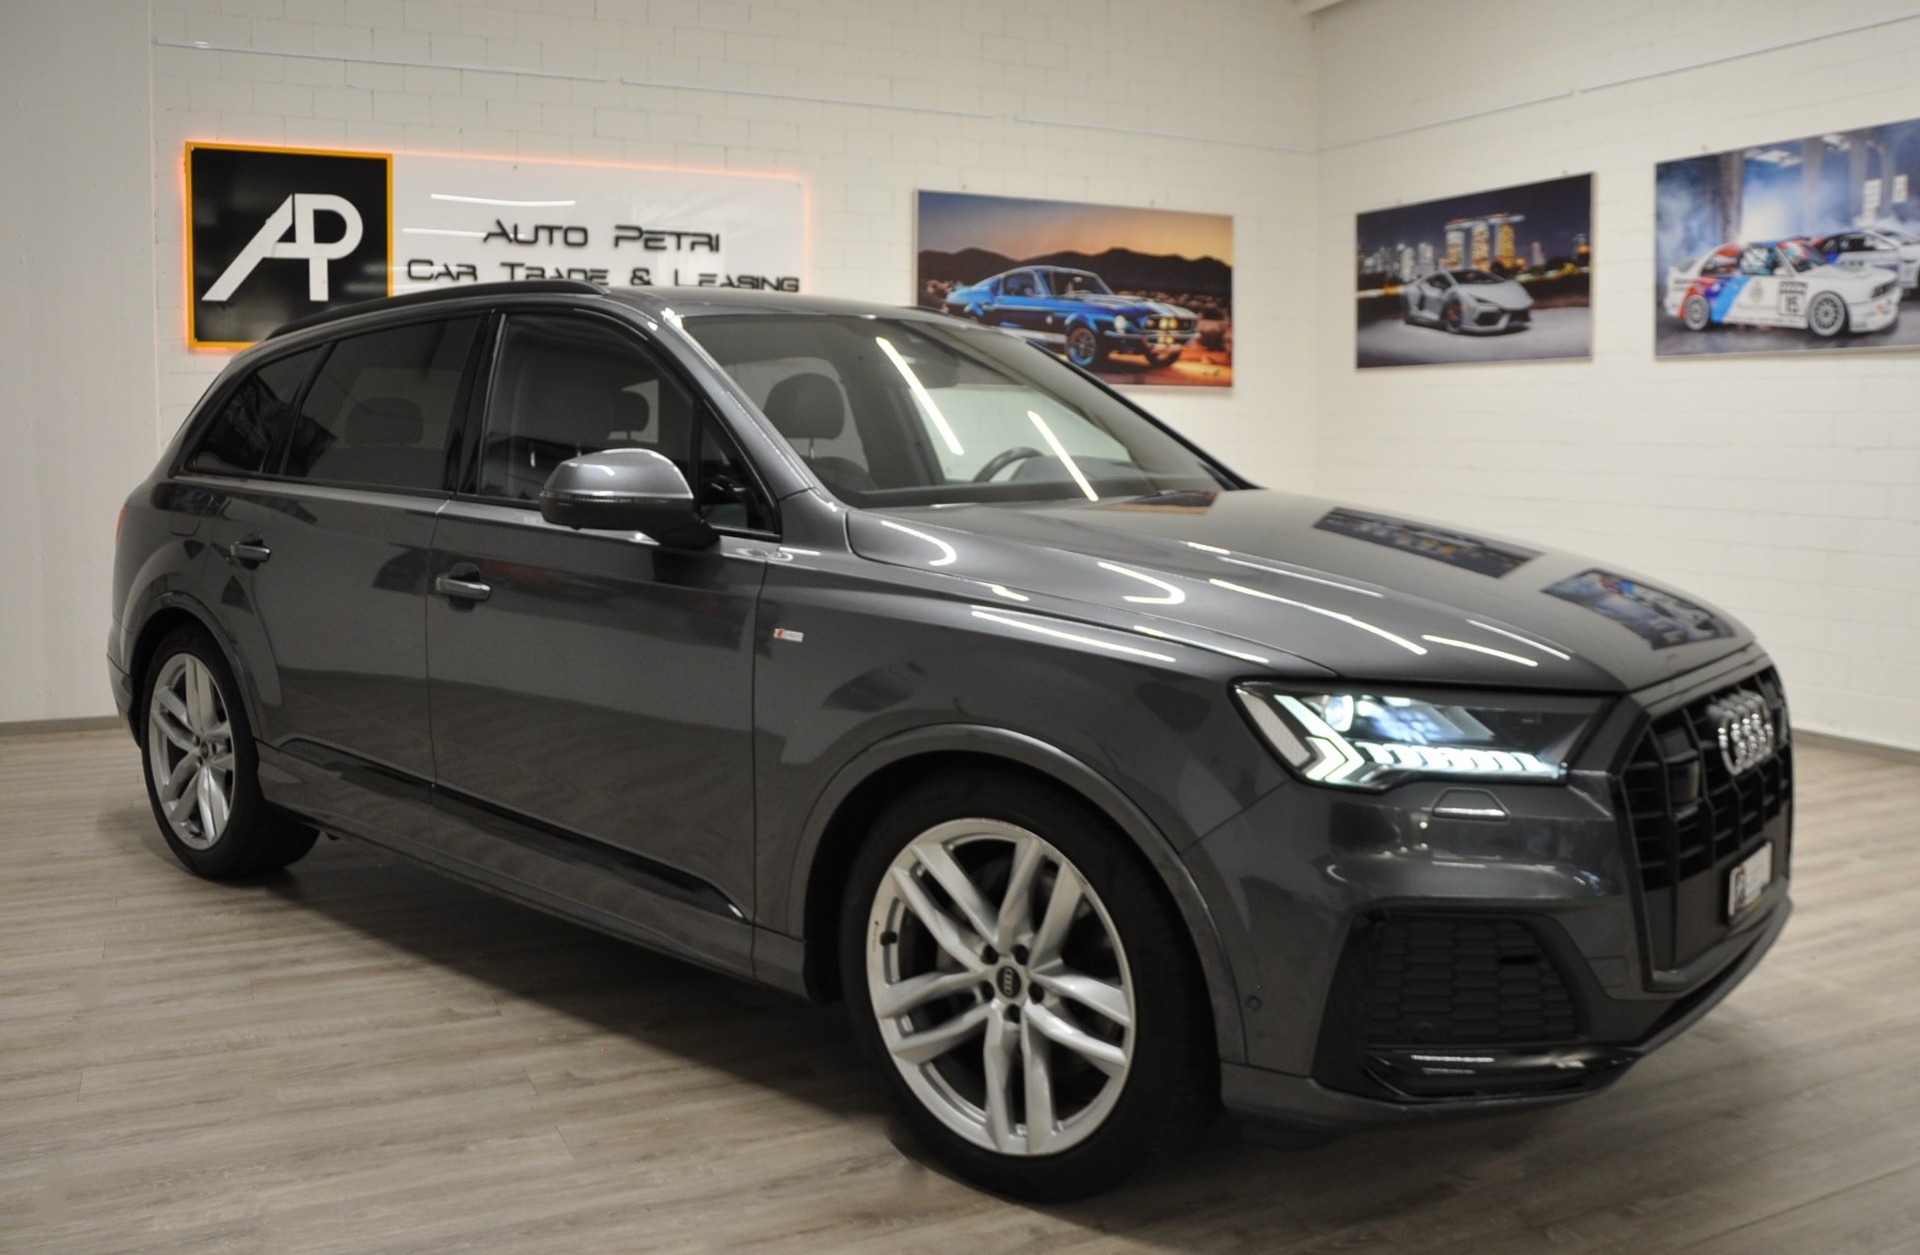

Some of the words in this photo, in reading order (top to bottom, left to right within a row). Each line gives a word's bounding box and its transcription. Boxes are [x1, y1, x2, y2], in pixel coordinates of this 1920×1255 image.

[201, 193, 363, 302] AP
[483, 218, 588, 247] AUTO
[614, 225, 720, 253] PETRI
[407, 259, 478, 281] CAR
[630, 267, 654, 286] &
